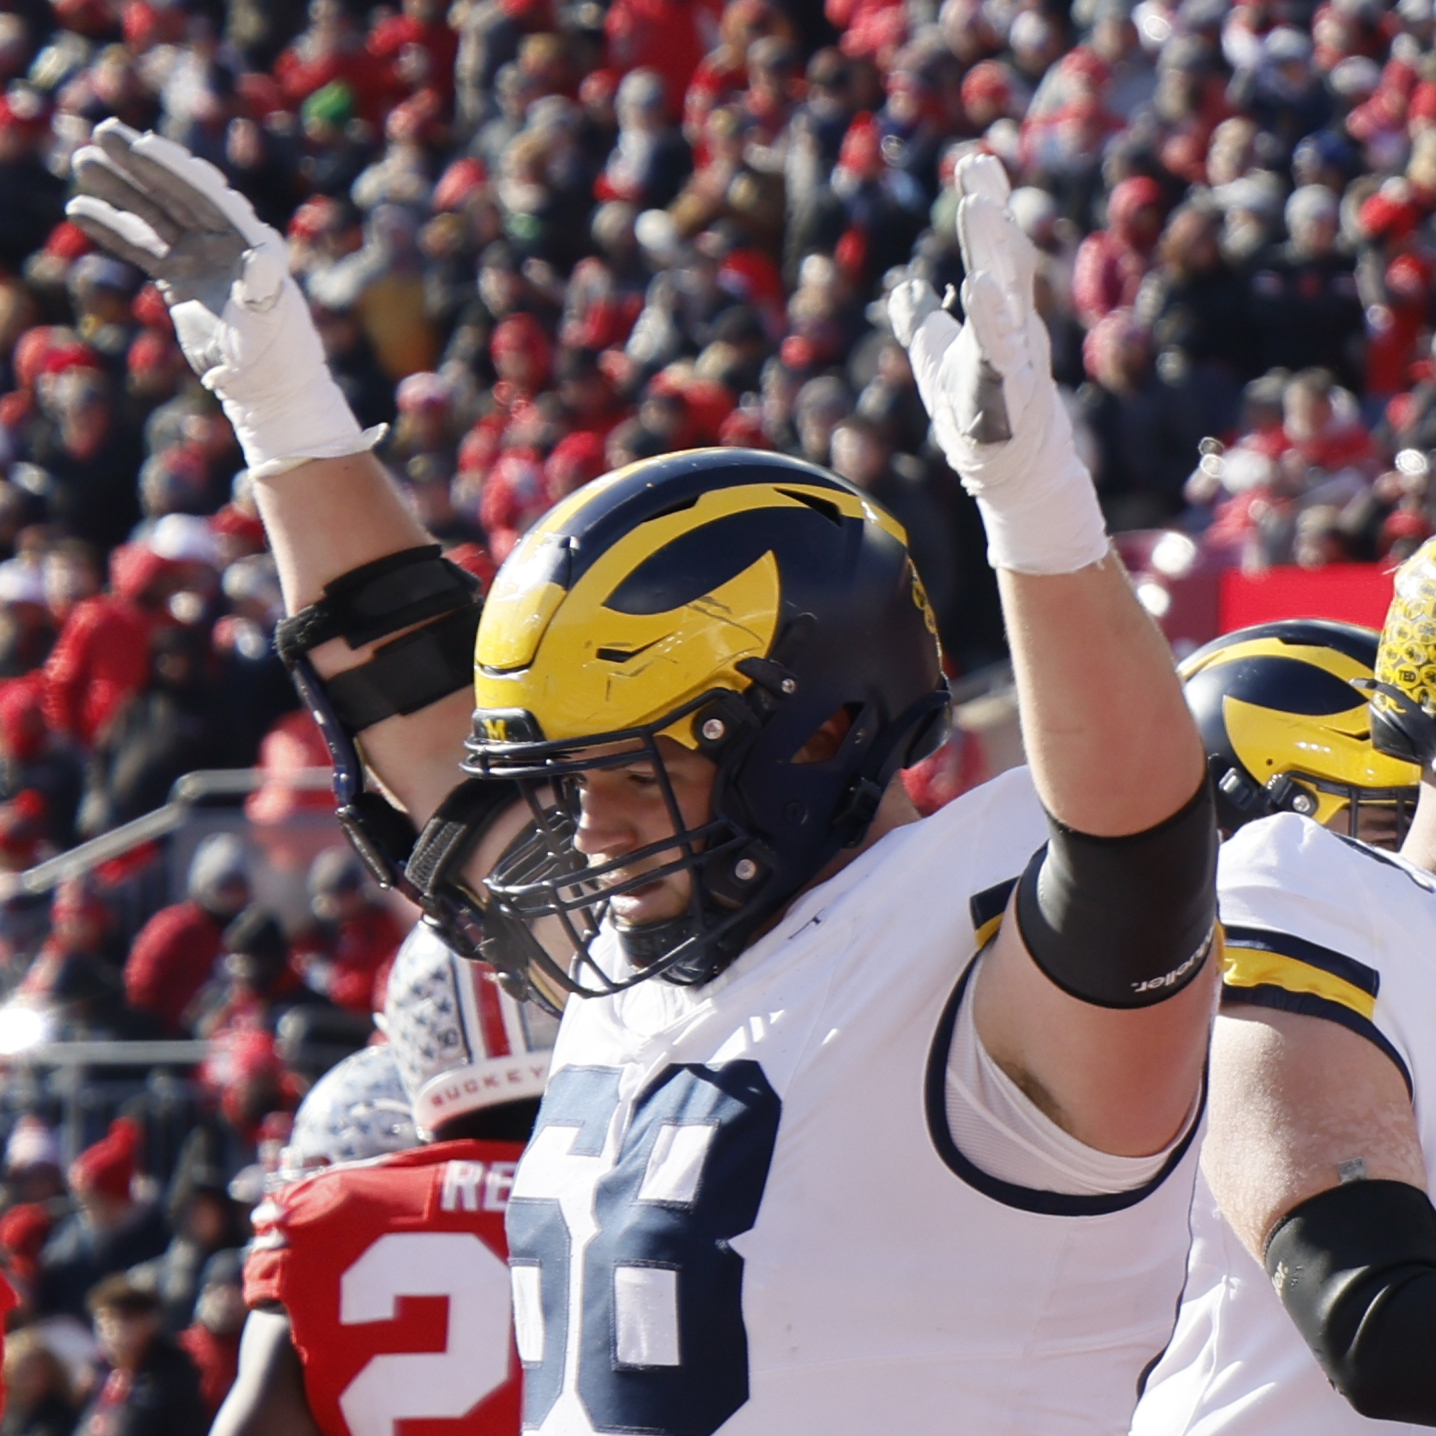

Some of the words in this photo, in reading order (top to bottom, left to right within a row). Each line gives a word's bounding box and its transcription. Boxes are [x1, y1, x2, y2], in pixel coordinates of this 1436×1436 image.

[483, 718, 508, 741] M
[430, 1064, 544, 1107] BUCKEY
[440, 1161, 511, 1213] RE
